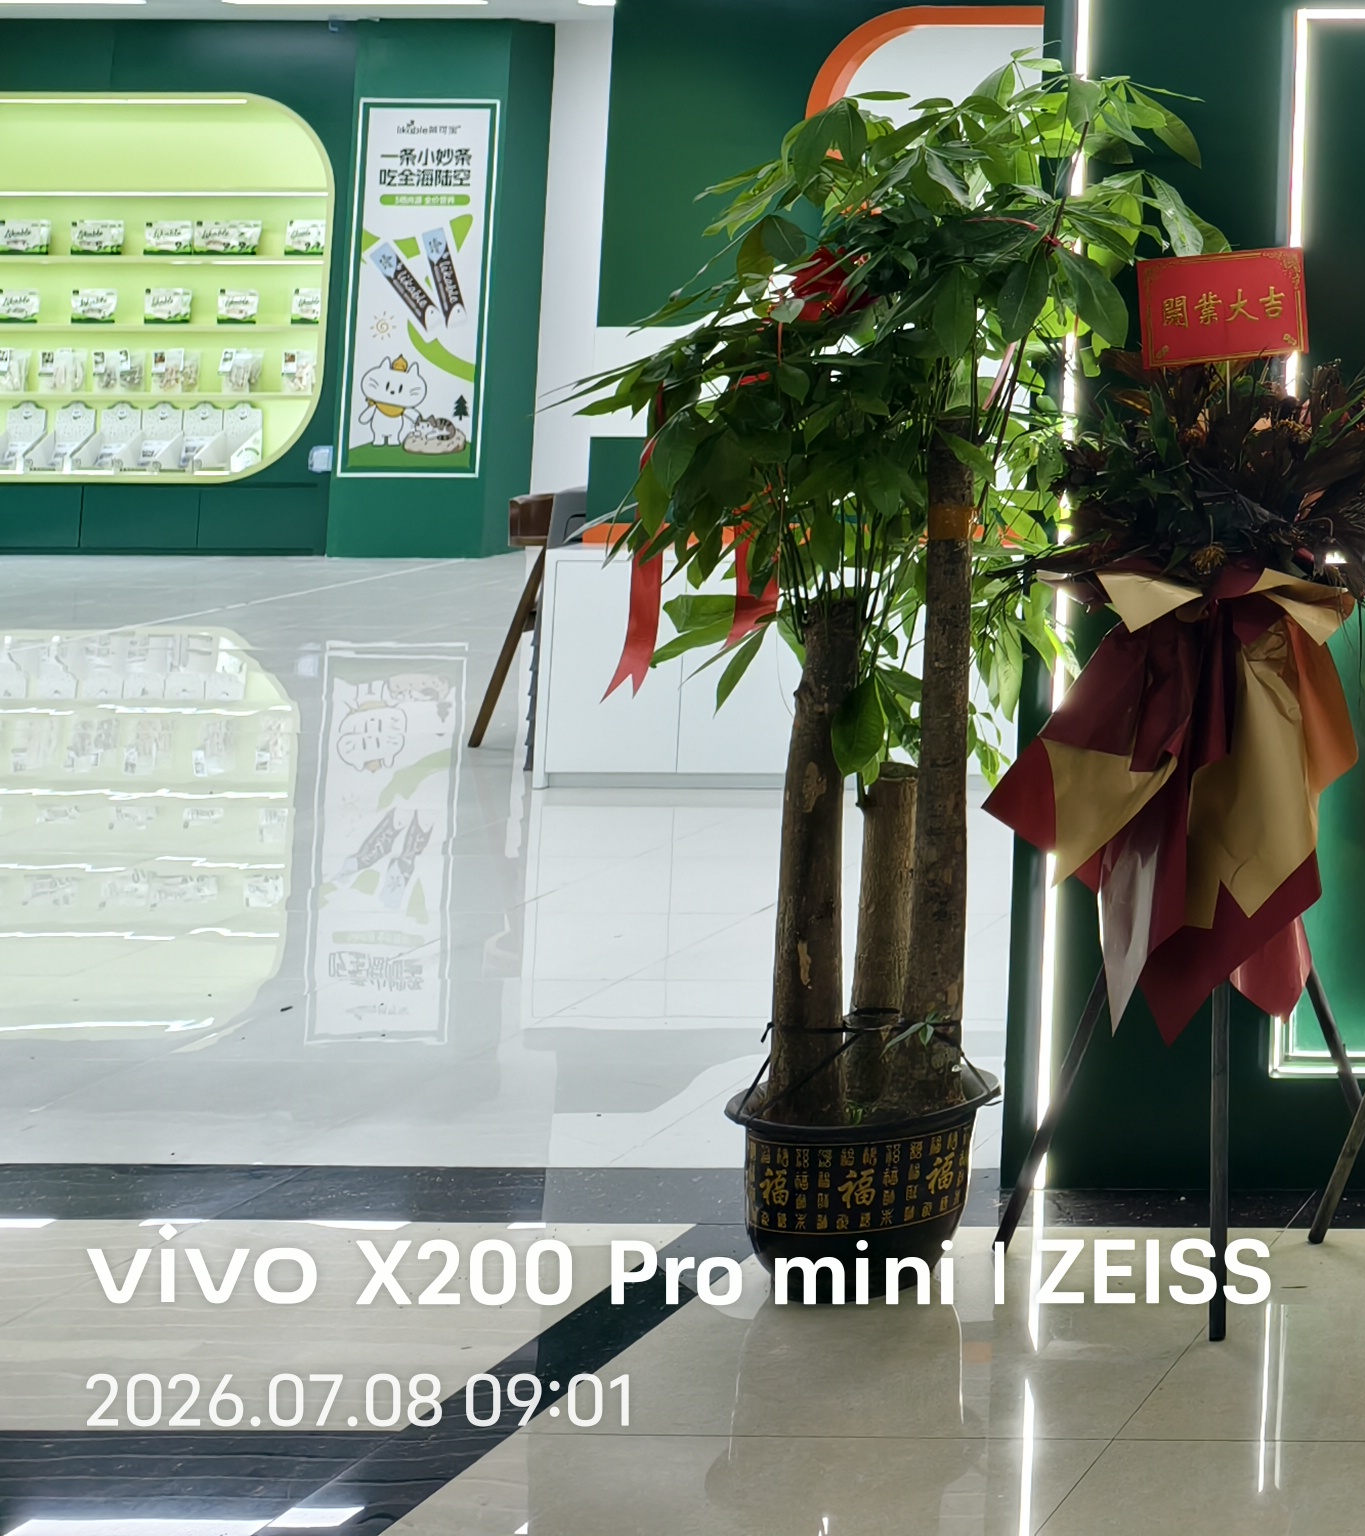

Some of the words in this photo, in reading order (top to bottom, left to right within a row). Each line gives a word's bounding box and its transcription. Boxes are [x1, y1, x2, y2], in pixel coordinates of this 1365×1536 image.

[380, 147, 472, 166] 一条小妙条
[379, 168, 471, 187] 吃全海陆空
[1162, 286, 1286, 328] 開業大吉
[760, 1167, 790, 1206] 福
[837, 1168, 876, 1209] 福
[925, 1151, 955, 1195] 福
